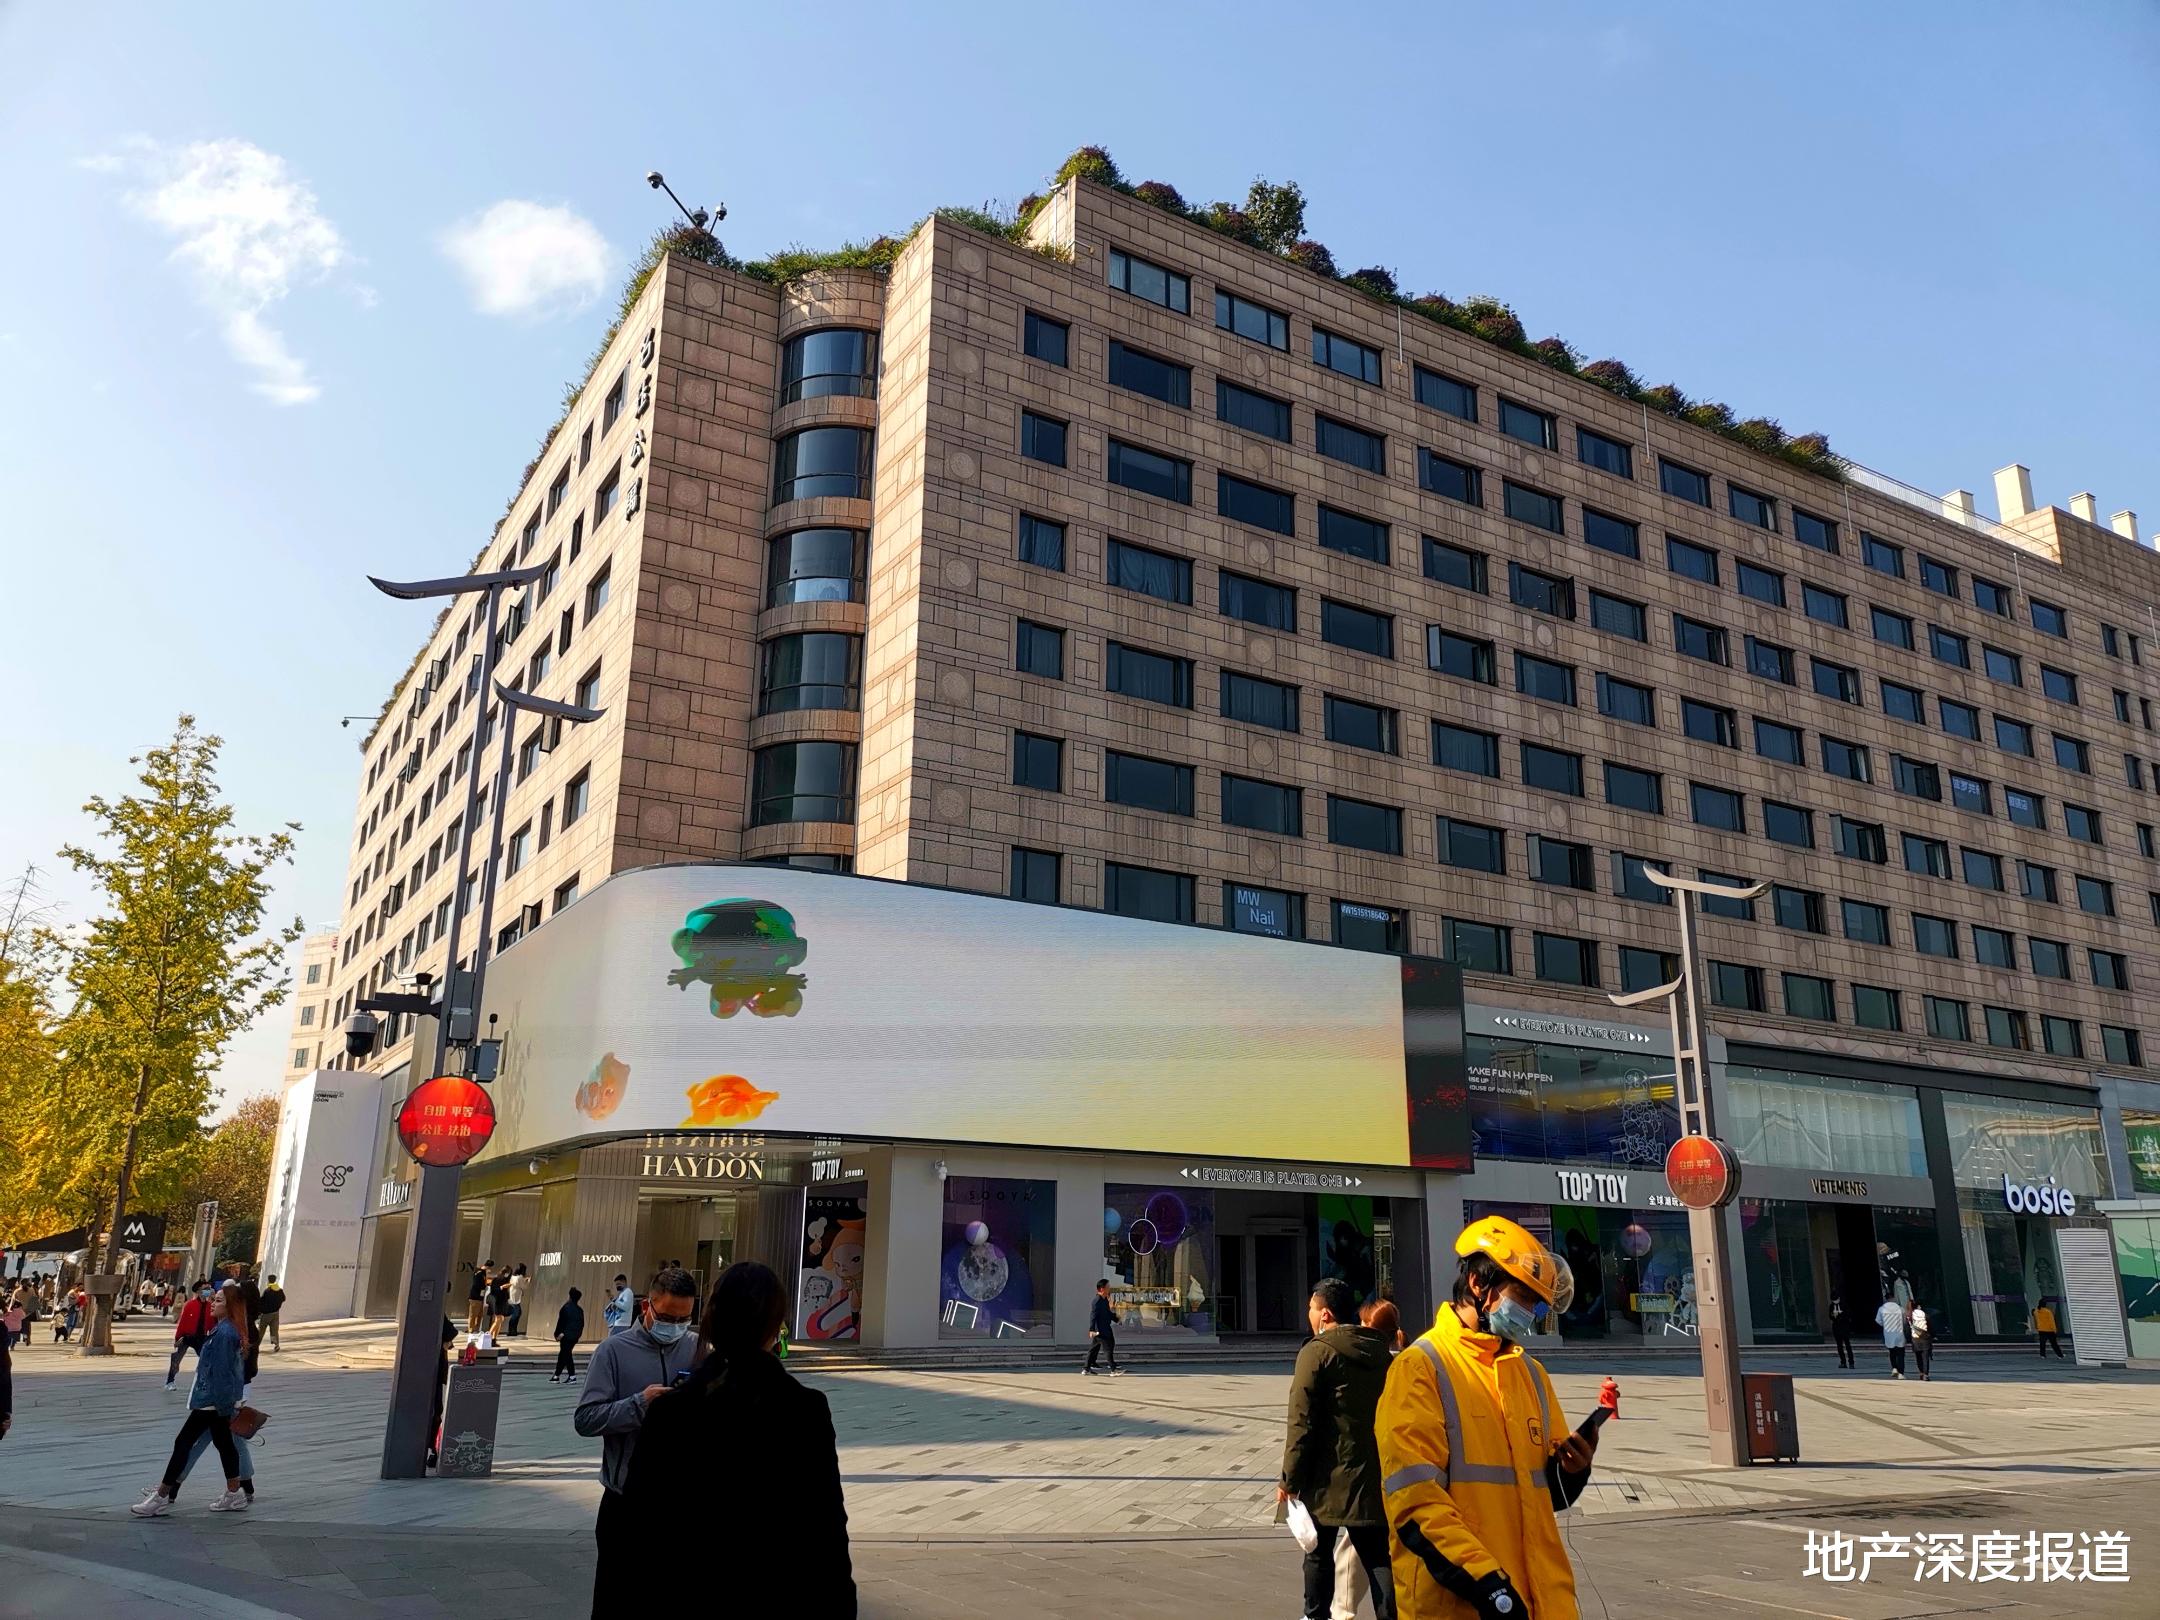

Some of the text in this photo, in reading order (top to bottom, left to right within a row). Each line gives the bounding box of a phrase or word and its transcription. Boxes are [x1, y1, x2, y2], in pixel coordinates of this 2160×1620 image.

[1237, 889, 1260, 906] MW
[1250, 907, 1275, 925] Nail
[1492, 1069, 1512, 1078] FUN
[1513, 1071, 1553, 1082] HAPPEN
[641, 1155, 765, 1180] HAYDON
[811, 1158, 841, 1182] TOP TOY
[1202, 1167, 1343, 1187] EVERYONE IS PLAYER ONE
[1556, 1171, 1628, 1204] TOP TOY
[1811, 1178, 1868, 1196] VETEMENTS
[2002, 1173, 2076, 1217] bosie
[582, 1254, 622, 1263] HAYDON
